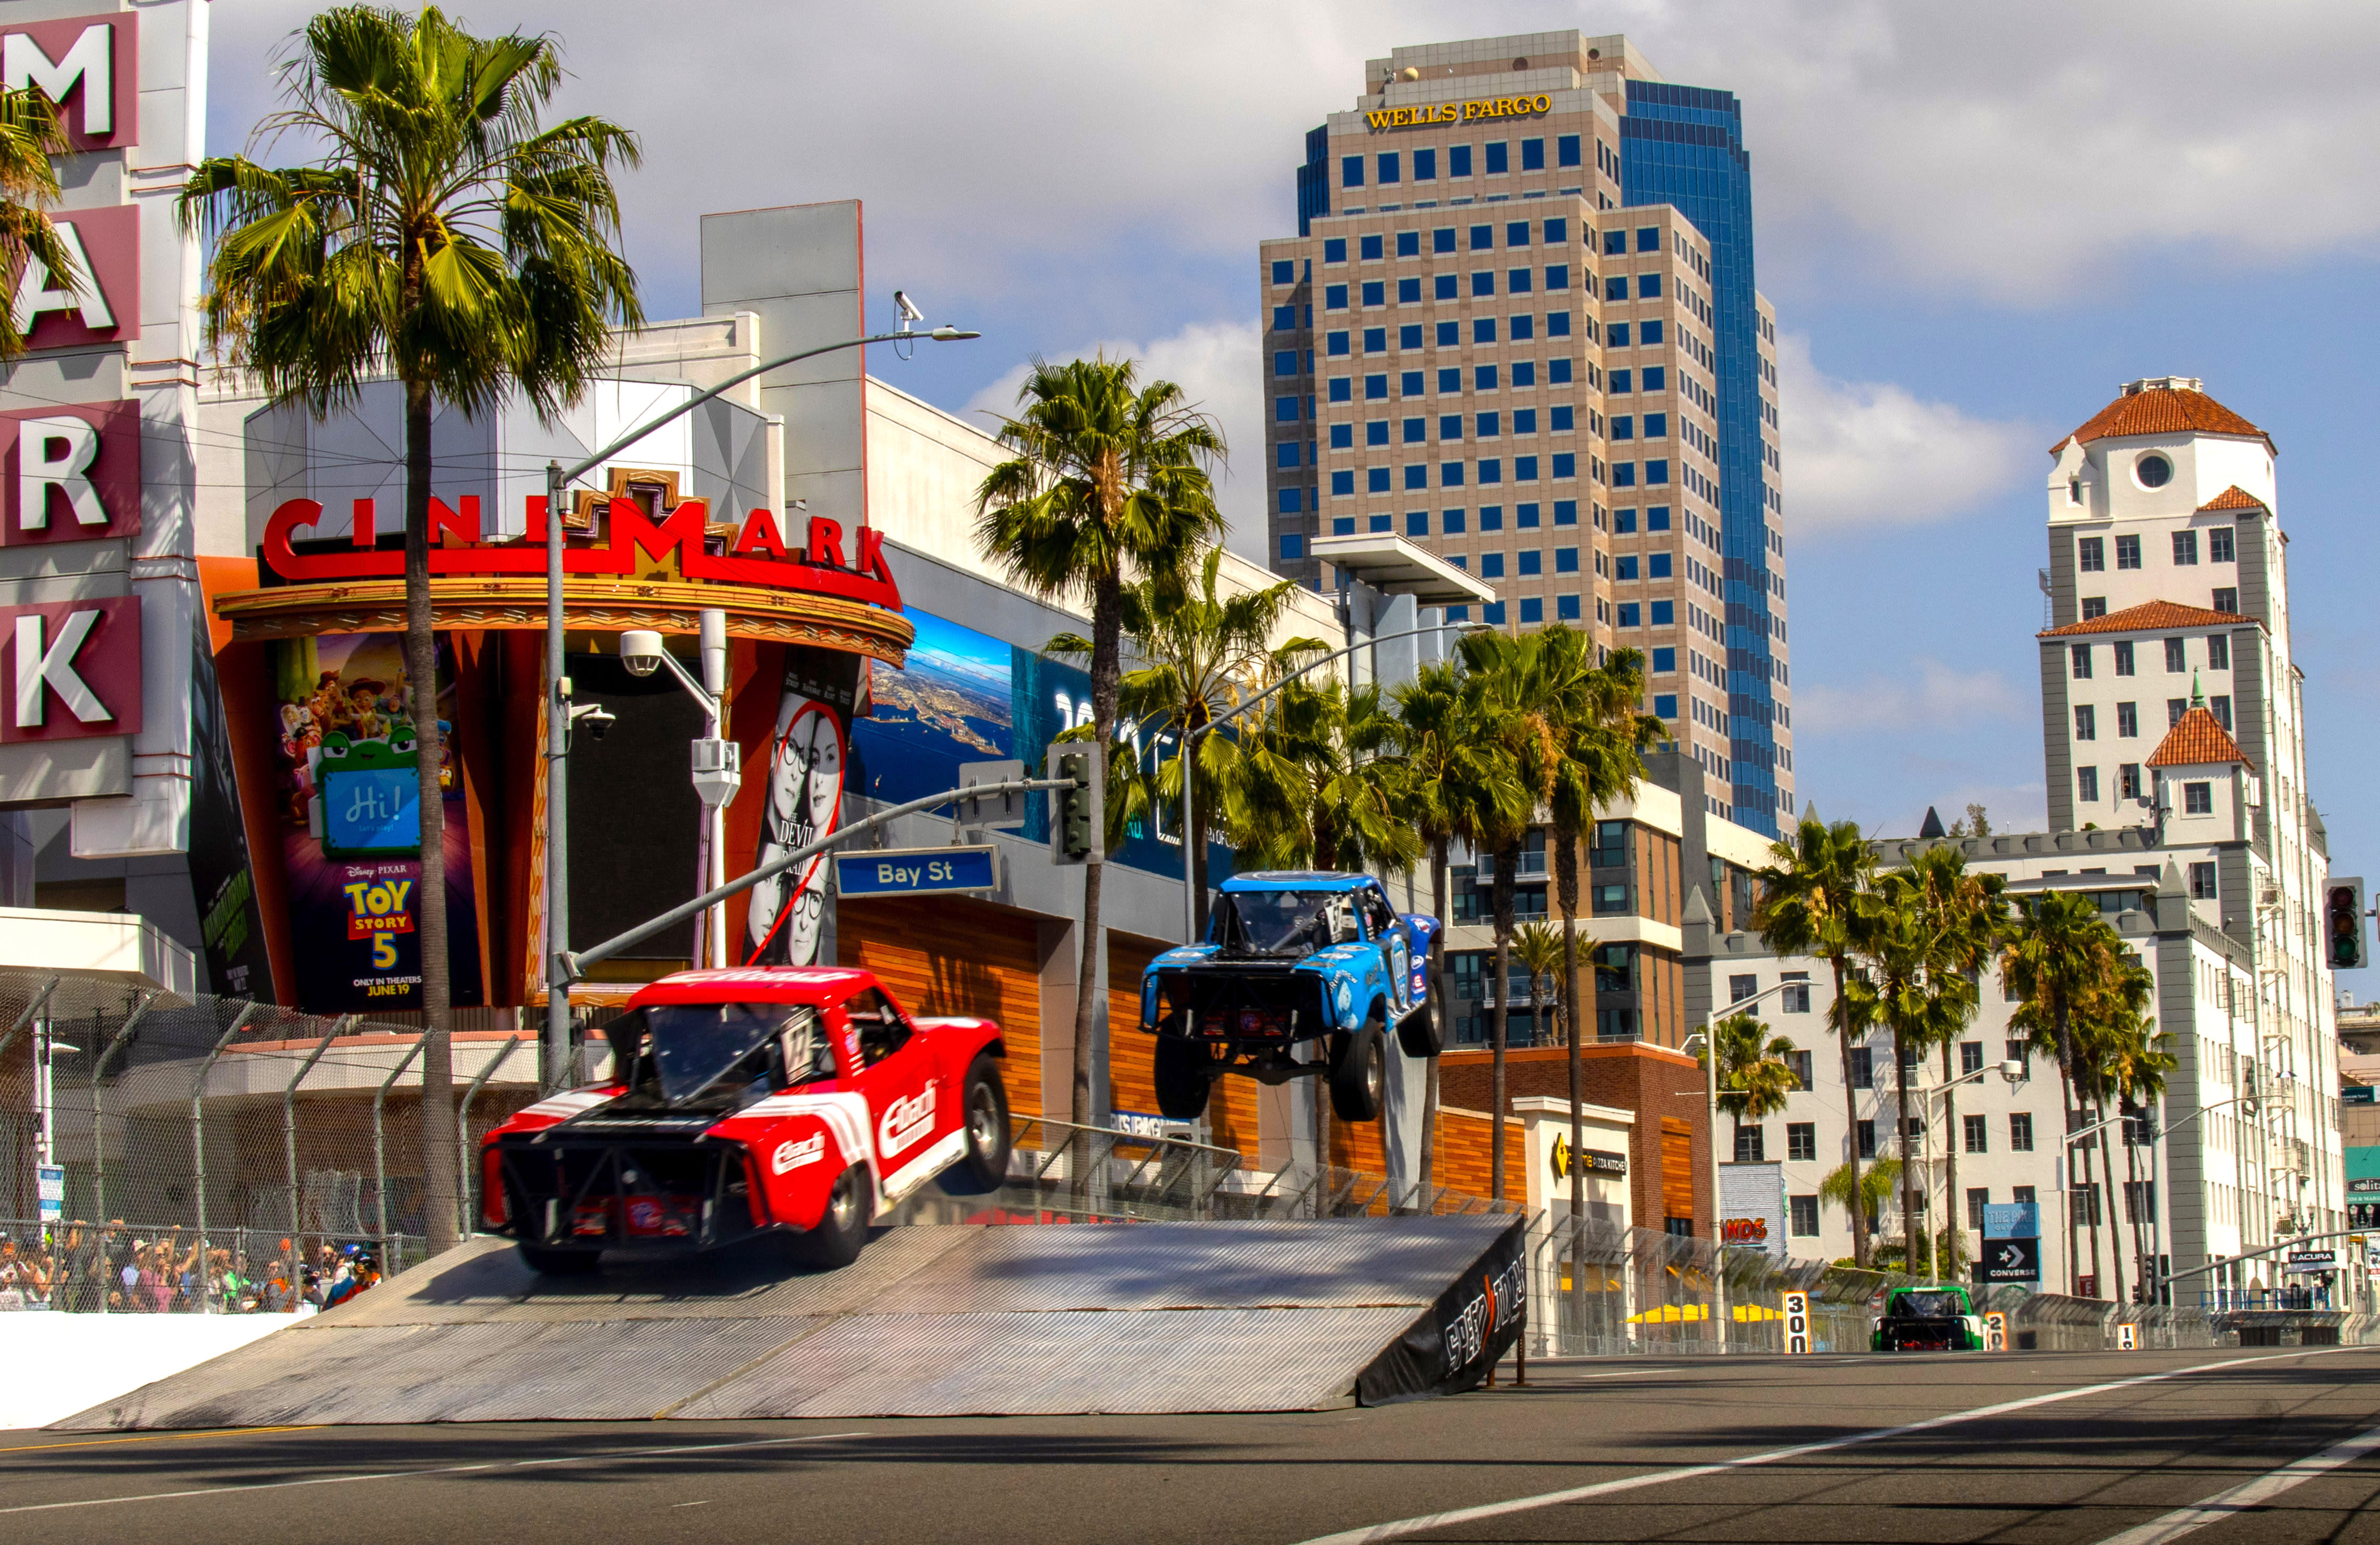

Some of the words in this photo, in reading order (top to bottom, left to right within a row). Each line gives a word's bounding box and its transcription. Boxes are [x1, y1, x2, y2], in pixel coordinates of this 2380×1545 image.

[1366, 103, 1457, 129] WELLS
[1463, 94, 1551, 120] FARGO
[346, 785, 400, 822] Hi!
[378, 864, 407, 875] PIXAR
[877, 863, 921, 887] Bay
[928, 861, 953, 881] St
[355, 916, 407, 930] STORY
[372, 931, 399, 970] 5
[386, 976, 422, 984] THEATERS
[367, 985, 396, 997] JUNE
[398, 984, 410, 995] 19
[1593, 1157, 1607, 1169] PIZZA
[1987, 1210, 2008, 1224] THE
[1788, 1295, 1806, 1352] 300
